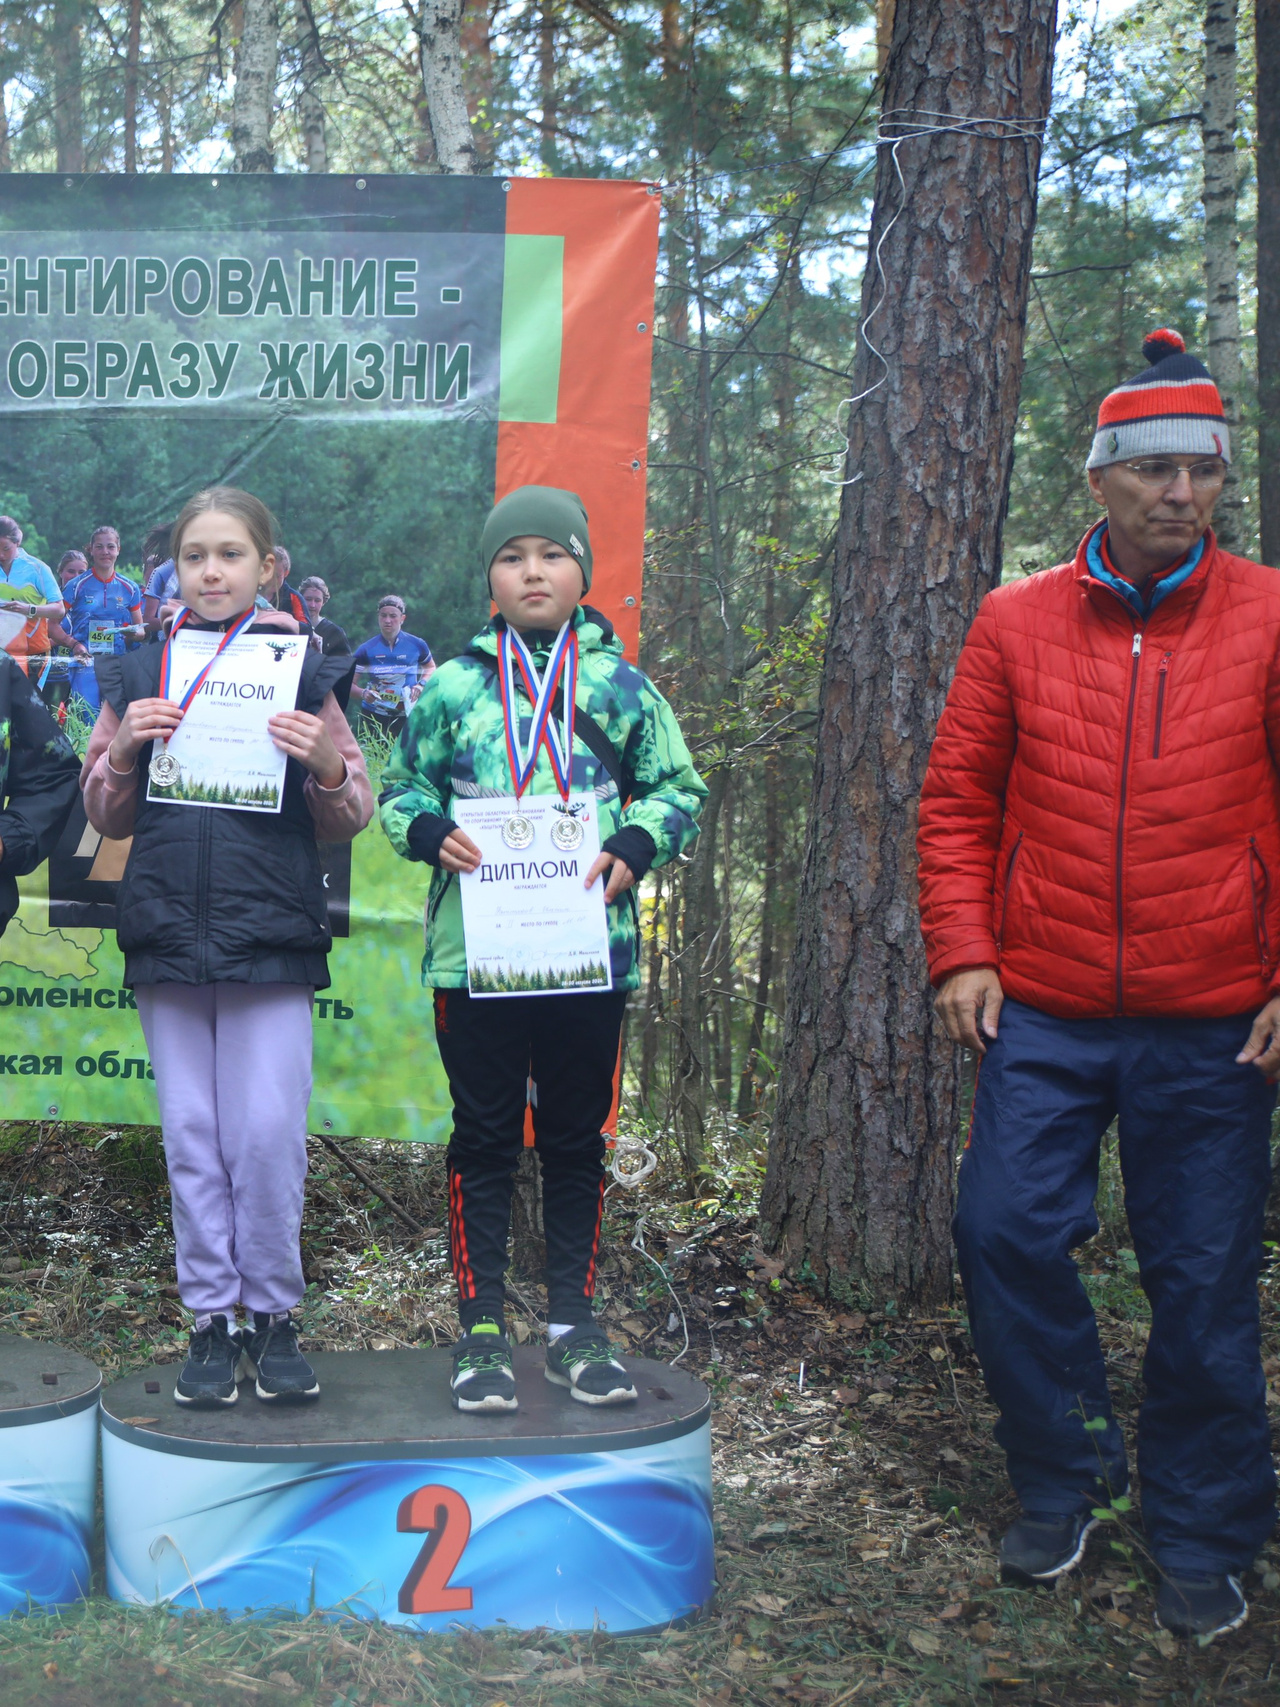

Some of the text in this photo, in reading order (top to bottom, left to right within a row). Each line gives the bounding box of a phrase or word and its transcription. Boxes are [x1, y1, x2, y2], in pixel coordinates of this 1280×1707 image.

[7, 340, 240, 401] ОБРАЗУ
[260, 341, 471, 401] ЖИЗНИ
[480, 860, 579, 883] ДИПЛОМ
[396, 1483, 473, 1615] 2
